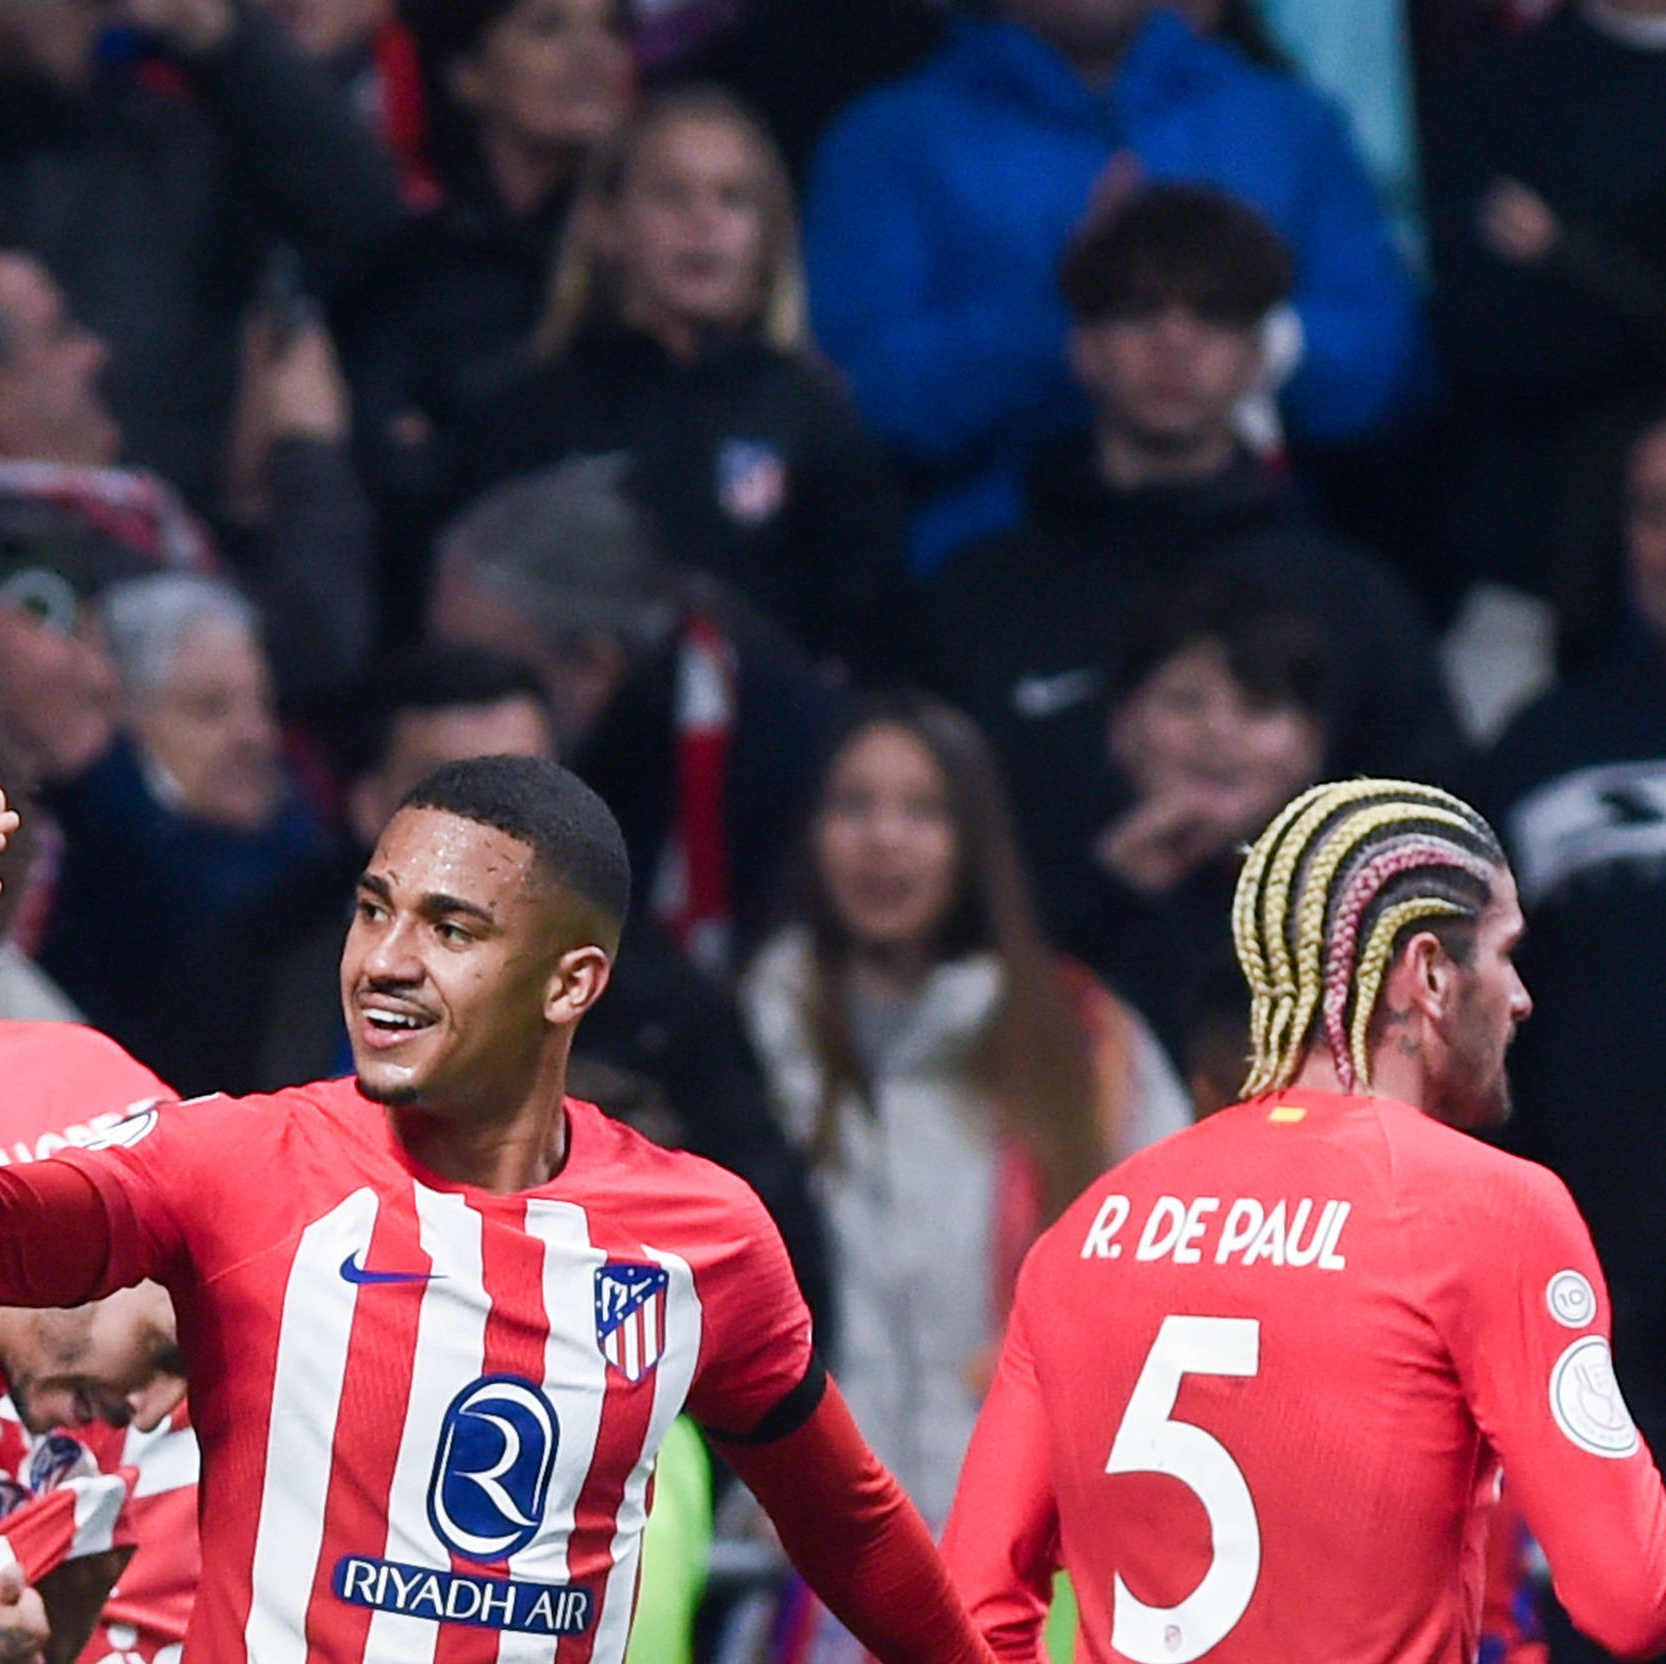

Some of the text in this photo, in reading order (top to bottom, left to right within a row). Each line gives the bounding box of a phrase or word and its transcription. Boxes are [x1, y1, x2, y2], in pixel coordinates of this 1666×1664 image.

[1081, 1195, 1352, 1271] R. DE PAUL
[343, 1559, 588, 1630] RIYADH AIR
